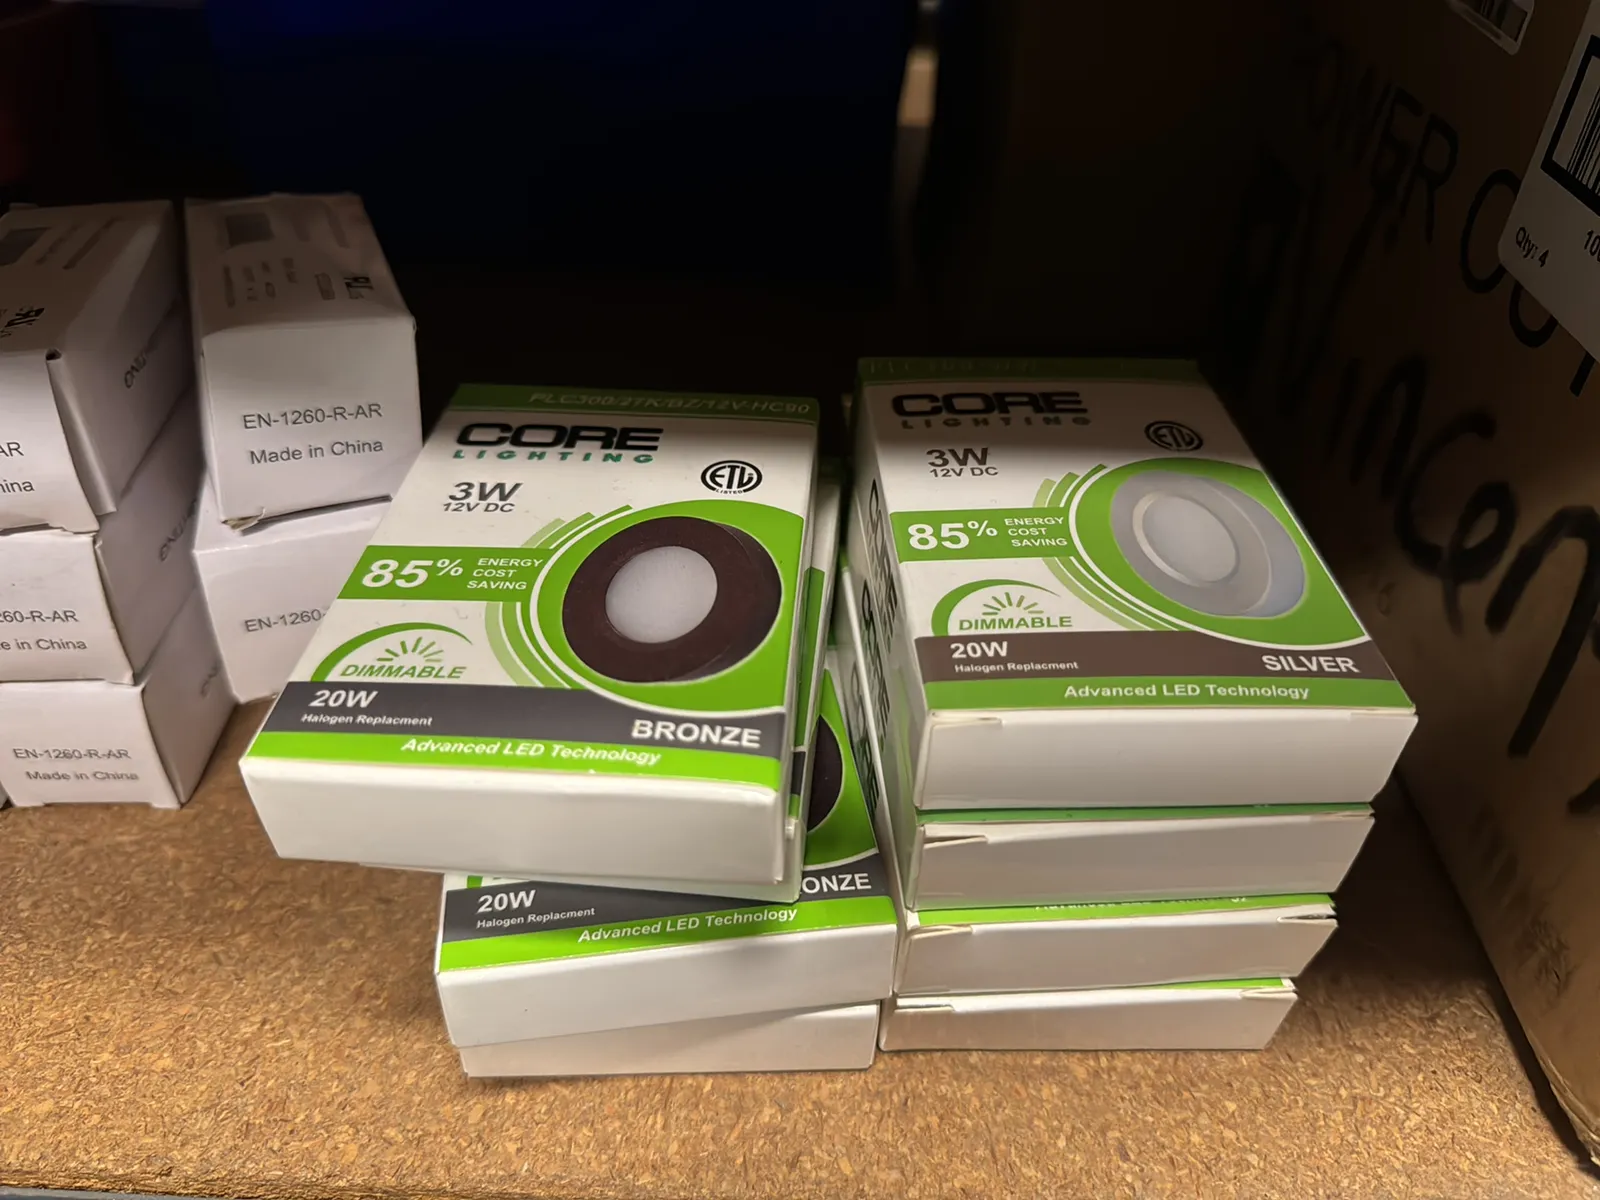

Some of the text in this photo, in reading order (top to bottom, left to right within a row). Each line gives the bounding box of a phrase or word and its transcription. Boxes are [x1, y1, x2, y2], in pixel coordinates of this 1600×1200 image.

[1515, 226, 1549, 268] Qty: 4
[891, 391, 1088, 417] CORE
[242, 403, 383, 430] EN-1260-R-AR
[901, 416, 1091, 430] LIGHTING
[456, 422, 664, 451] CORE
[250, 439, 384, 465] Made in China
[453, 449, 654, 464] LIGHTING
[926, 448, 988, 467] 3W
[930, 466, 999, 478] 12V DC
[449, 482, 523, 502] 3W
[443, 502, 516, 513] 12V DC
[1004, 516, 1064, 526] ENERGY
[907, 520, 997, 550] 85%
[1008, 527, 1047, 536] COST
[1011, 538, 1067, 548] SAVING
[477, 558, 543, 568] ENERGY
[362, 558, 463, 588] 85%
[472, 569, 517, 578] COST
[466, 580, 528, 590] SAVING
[959, 615, 1073, 631] DIMMABLE
[14, 638, 32, 650] in
[36, 638, 87, 650] China
[949, 641, 1360, 673] 20W SILVER
[340, 664, 467, 679] DIMMABLE
[954, 661, 1079, 674] Halogen Replacment
[1064, 684, 1309, 700] Advanced LED Technology
[300, 713, 433, 727] Halogen Replacment
[308, 690, 761, 749] 20W BRONZE
[13, 748, 132, 761] EN-1260-R-AR
[401, 738, 661, 766] Advanced LED Technology
[26, 770, 139, 781] Made in China
[476, 873, 872, 914] 20W ONZE
[476, 907, 595, 929] Halogen Replacment
[577, 908, 797, 943] Advanced LED Technology
